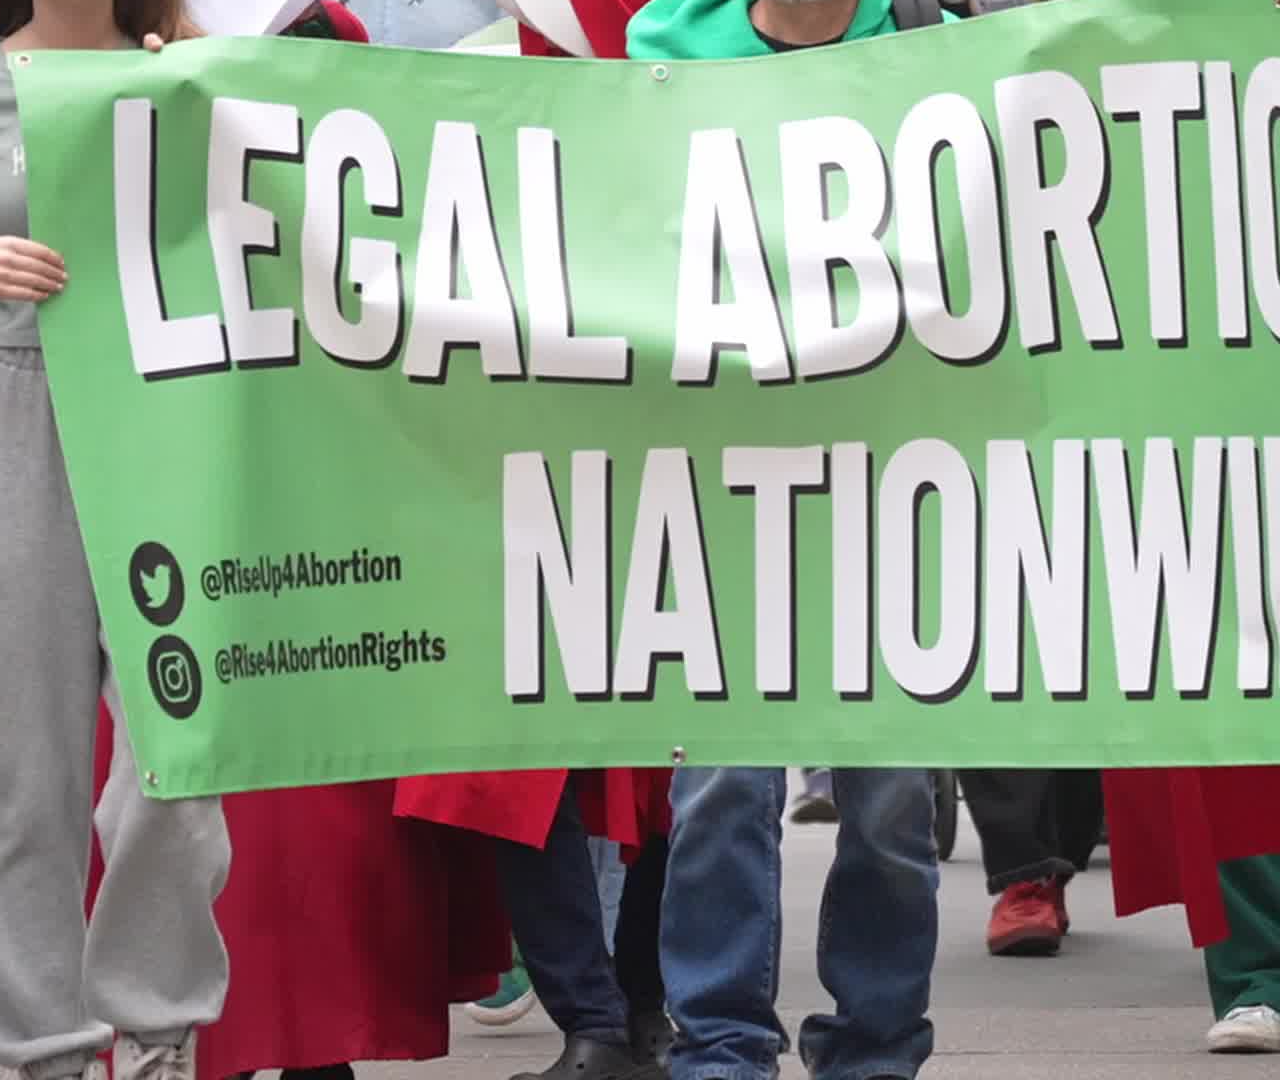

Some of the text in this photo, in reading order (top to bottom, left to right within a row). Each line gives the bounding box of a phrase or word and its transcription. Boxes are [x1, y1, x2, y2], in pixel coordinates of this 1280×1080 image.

[113, 98, 633, 386] LEGAL
[201, 547, 402, 600] @RiseUp4Abortion
[215, 630, 446, 684] @Rise4AbortionRights
